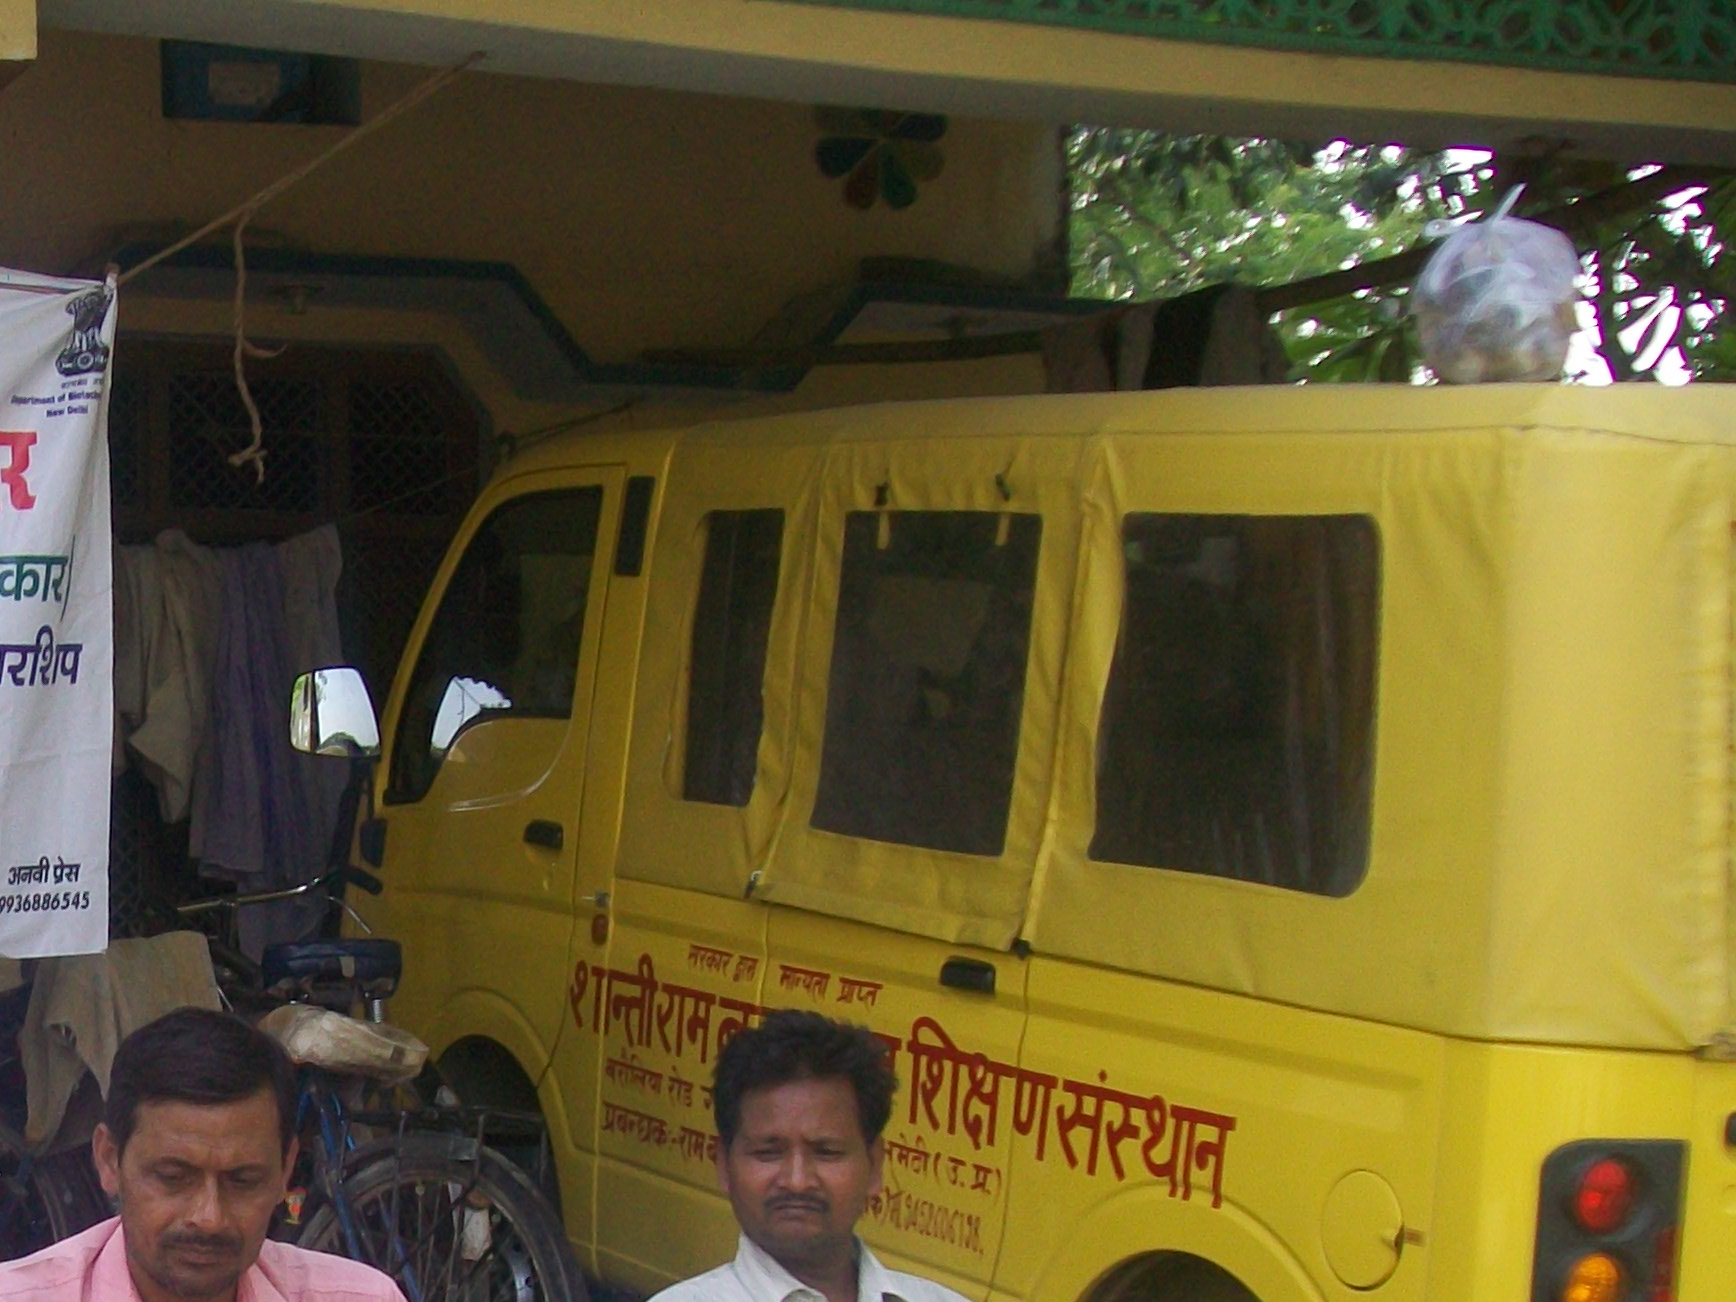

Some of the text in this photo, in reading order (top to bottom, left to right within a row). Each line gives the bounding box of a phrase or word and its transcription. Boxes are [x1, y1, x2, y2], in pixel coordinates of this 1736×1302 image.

[8, 855, 81, 885] अनवी प्रेस
[1057, 1069, 1236, 1209] संस्थान
